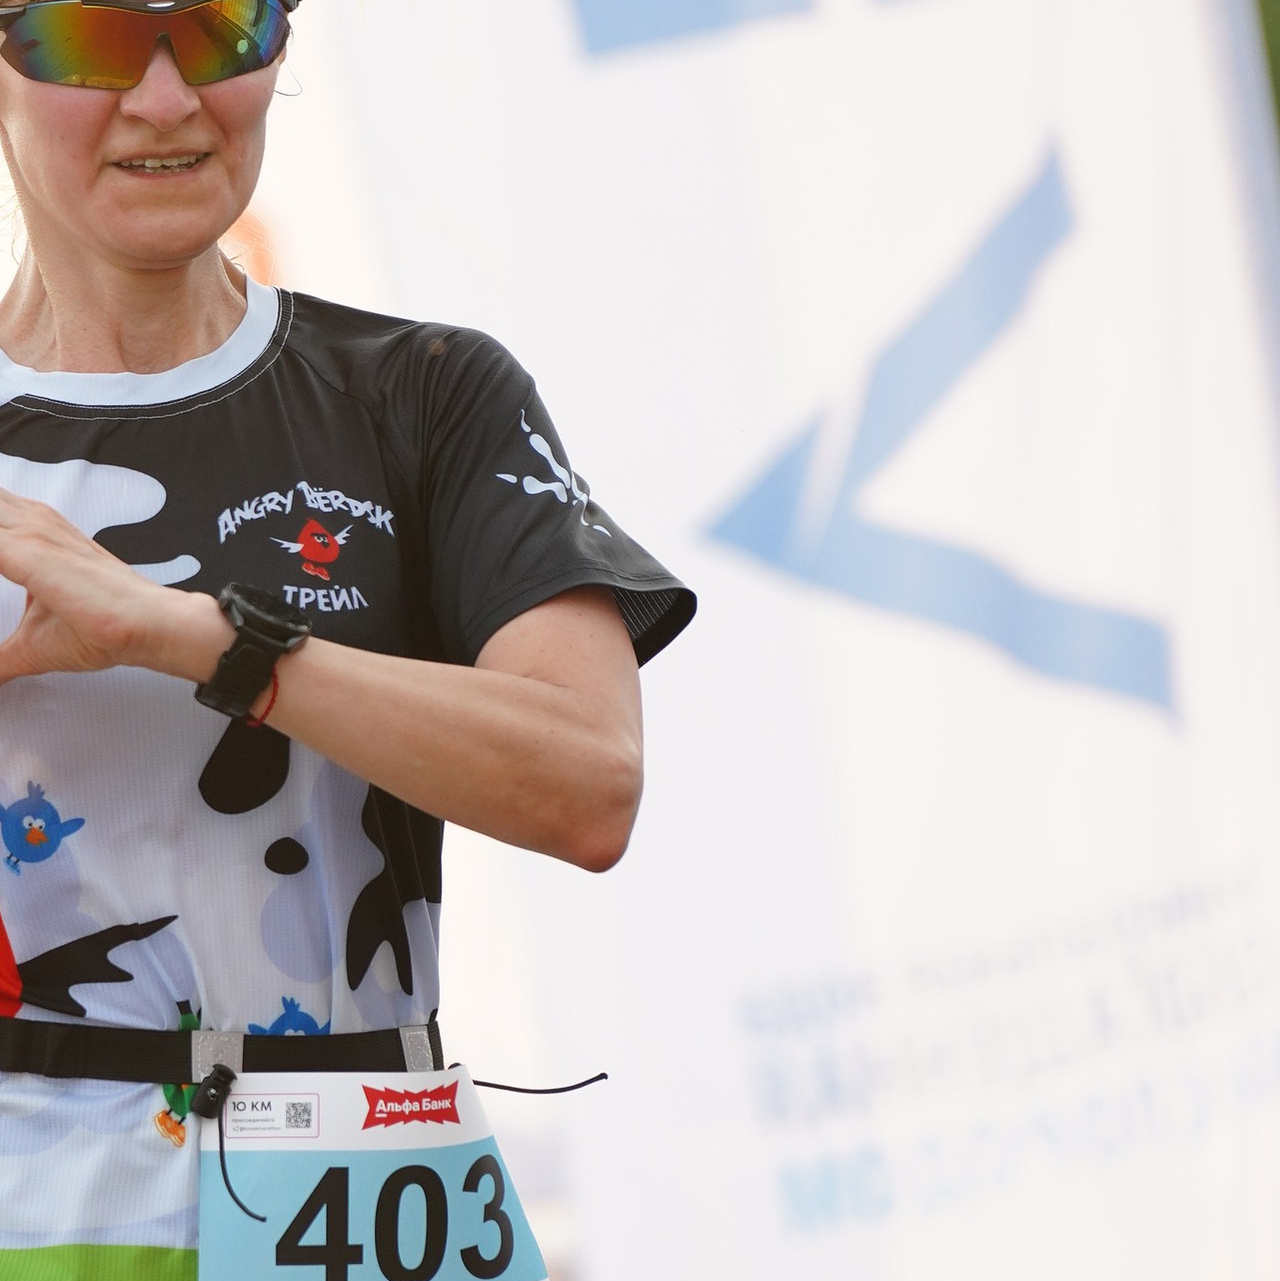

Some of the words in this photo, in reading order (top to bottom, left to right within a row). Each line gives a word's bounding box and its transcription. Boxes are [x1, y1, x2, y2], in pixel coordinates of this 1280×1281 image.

[218, 489, 294, 544] ANGRY
[282, 585, 369, 611] ТРЕЙЛ
[232, 1101, 247, 1112] 10
[375, 1099, 420, 1117] Альфа
[422, 1098, 452, 1111] Банк
